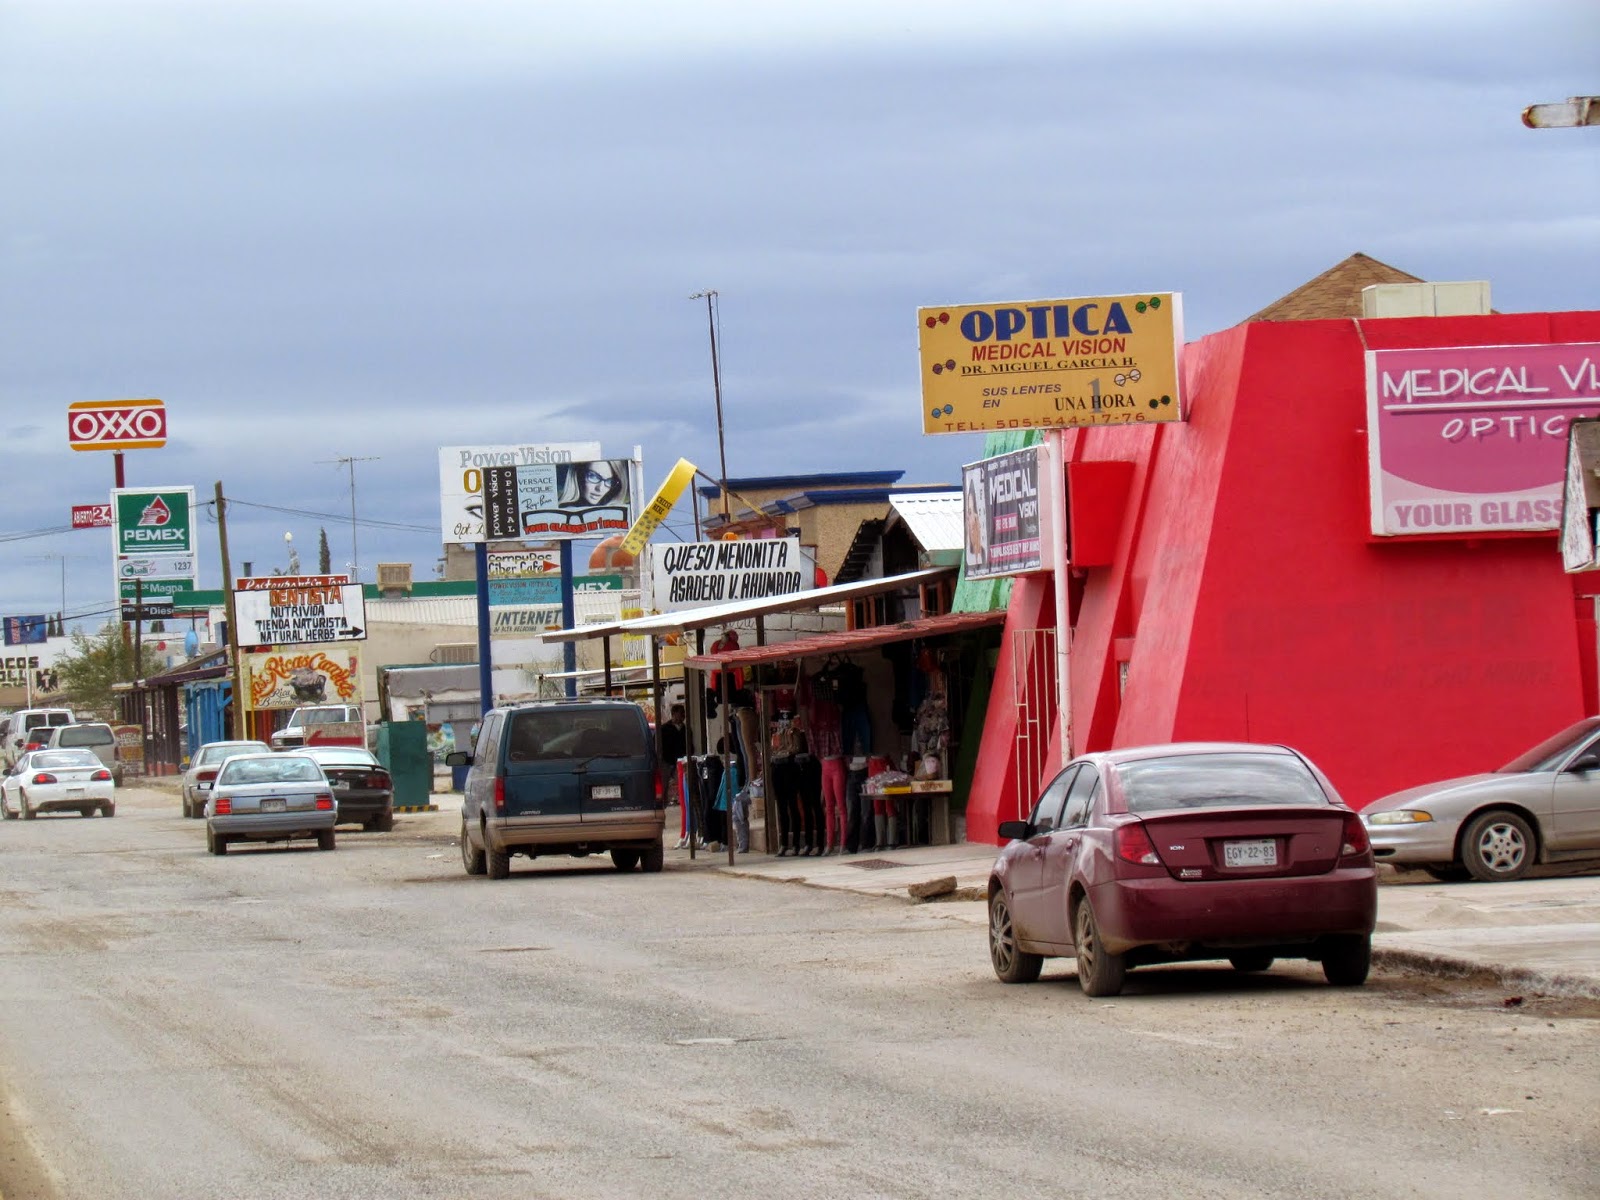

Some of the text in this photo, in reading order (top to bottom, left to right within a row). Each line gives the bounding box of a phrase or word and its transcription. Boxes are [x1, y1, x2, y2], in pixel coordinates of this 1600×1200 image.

[960, 302, 1133, 342] OPTICA
[971, 338, 1126, 362] MEDICAL VISION
[961, 357, 1138, 375] DR. MIGUEL GARCIA H.
[1383, 357, 1600, 403] MEDICAL VI
[982, 384, 1062, 397] SUS LENTES
[983, 399, 1000, 408] EN
[1054, 394, 1136, 411] UNA HORA
[72, 410, 162, 441] OXXO
[945, 412, 1146, 431] TEL: 505-544-17-76
[1441, 414, 1567, 439] OPTIC
[518, 477, 554, 486] VERSACE
[519, 486, 554, 494] VOGUE
[989, 468, 1037, 505] MEDICAL
[489, 469, 503, 536] power vision
[504, 470, 515, 533] OPTICAL
[1394, 503, 1473, 528] YOUR
[124, 528, 185, 542] PEMEX
[524, 523, 549, 535] YOUR
[664, 541, 788, 575] QUESO MENONITA
[489, 561, 516, 574] Ciber
[150, 583, 183, 595] Magna
[669, 573, 725, 603] ASADERO
[740, 571, 801, 599] AHUMADA
[269, 586, 343, 607] DENTISTA
[150, 606, 175, 615] Dies
[270, 605, 325, 619] NUTRIVIDA
[495, 610, 562, 626] INTERNET
[255, 617, 348, 631] TIENDA NATURISTA
[260, 629, 335, 643] NATURAL HERBS
[1226, 846, 1275, 859] EGY-22-83
